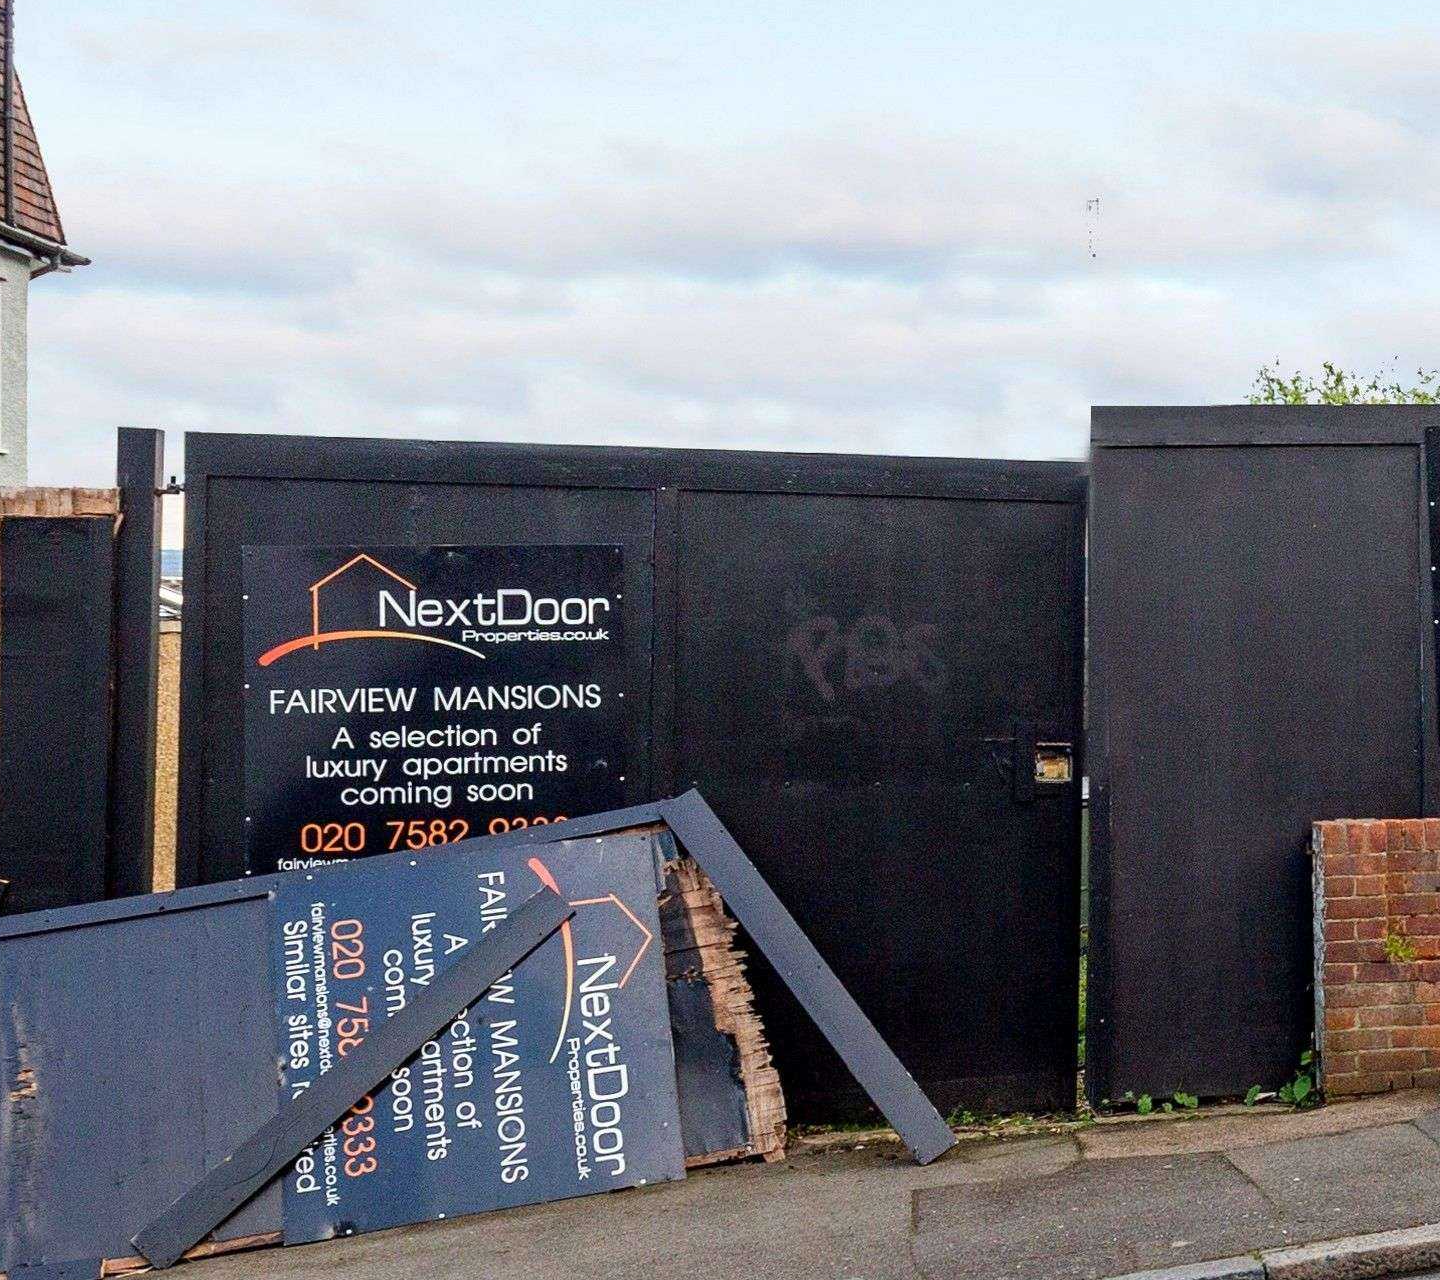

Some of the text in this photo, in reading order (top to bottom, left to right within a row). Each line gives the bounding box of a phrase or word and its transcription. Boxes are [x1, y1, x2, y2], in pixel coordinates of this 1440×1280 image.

[379, 588, 609, 628] NextDoor
[462, 628, 609, 644] Properties.co.uk
[270, 684, 602, 714] FAIRVIEW MANSIONS
[306, 750, 568, 781] luxury apartments
[332, 723, 542, 749] A selection of
[341, 782, 534, 808] coming soon
[301, 822, 366, 852] 020
[283, 920, 310, 1002] Similar
[330, 918, 366, 981] 020
[410, 911, 436, 986] luxury
[288, 1014, 313, 1070] sites
[443, 933, 468, 955] A
[456, 1100, 482, 1128] of
[577, 953, 629, 1176] NextDoor
[390, 1067, 414, 1133] soon
[489, 1019, 529, 1184] MANSIONS
[565, 1037, 591, 1181] Properties.co.uk
